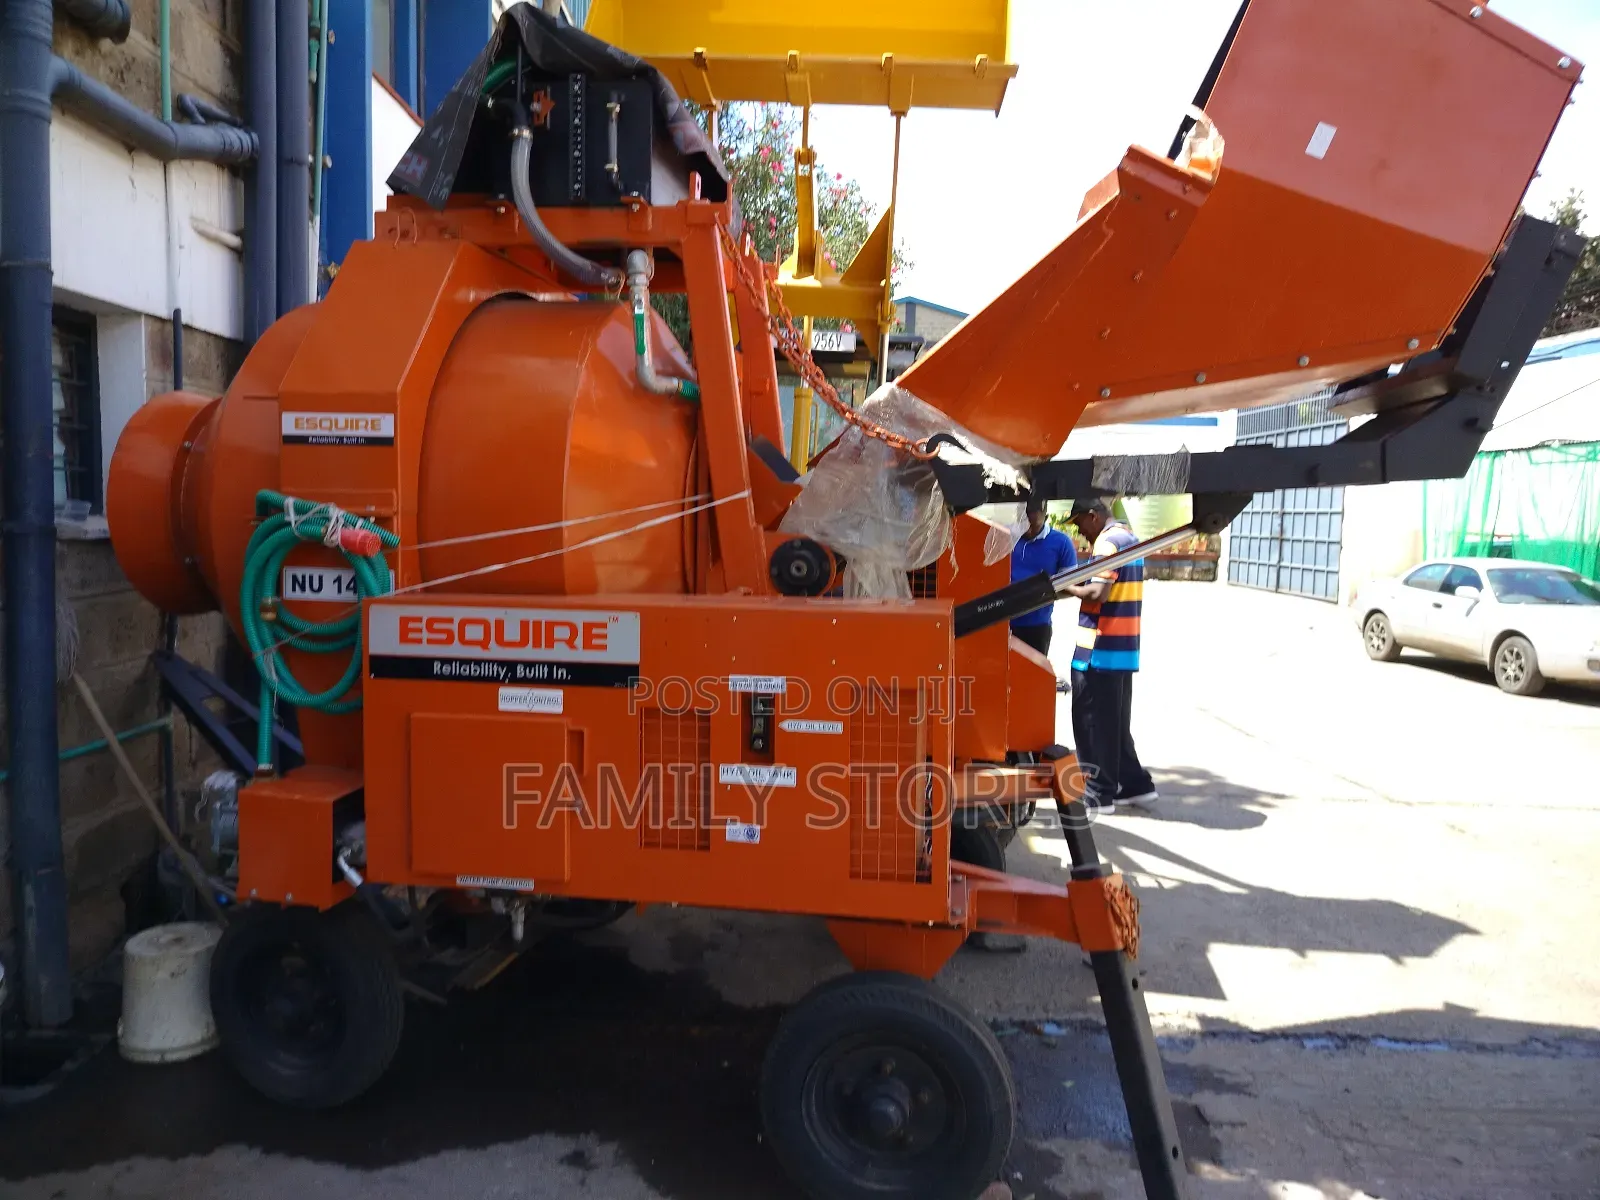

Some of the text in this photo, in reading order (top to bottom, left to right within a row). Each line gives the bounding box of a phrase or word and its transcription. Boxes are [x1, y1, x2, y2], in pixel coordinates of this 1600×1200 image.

[294, 415, 382, 432] ESQUIRE
[291, 573, 324, 594] NU
[399, 616, 608, 652] ESQUIRE
[433, 660, 572, 684] Reliability, Built In.
